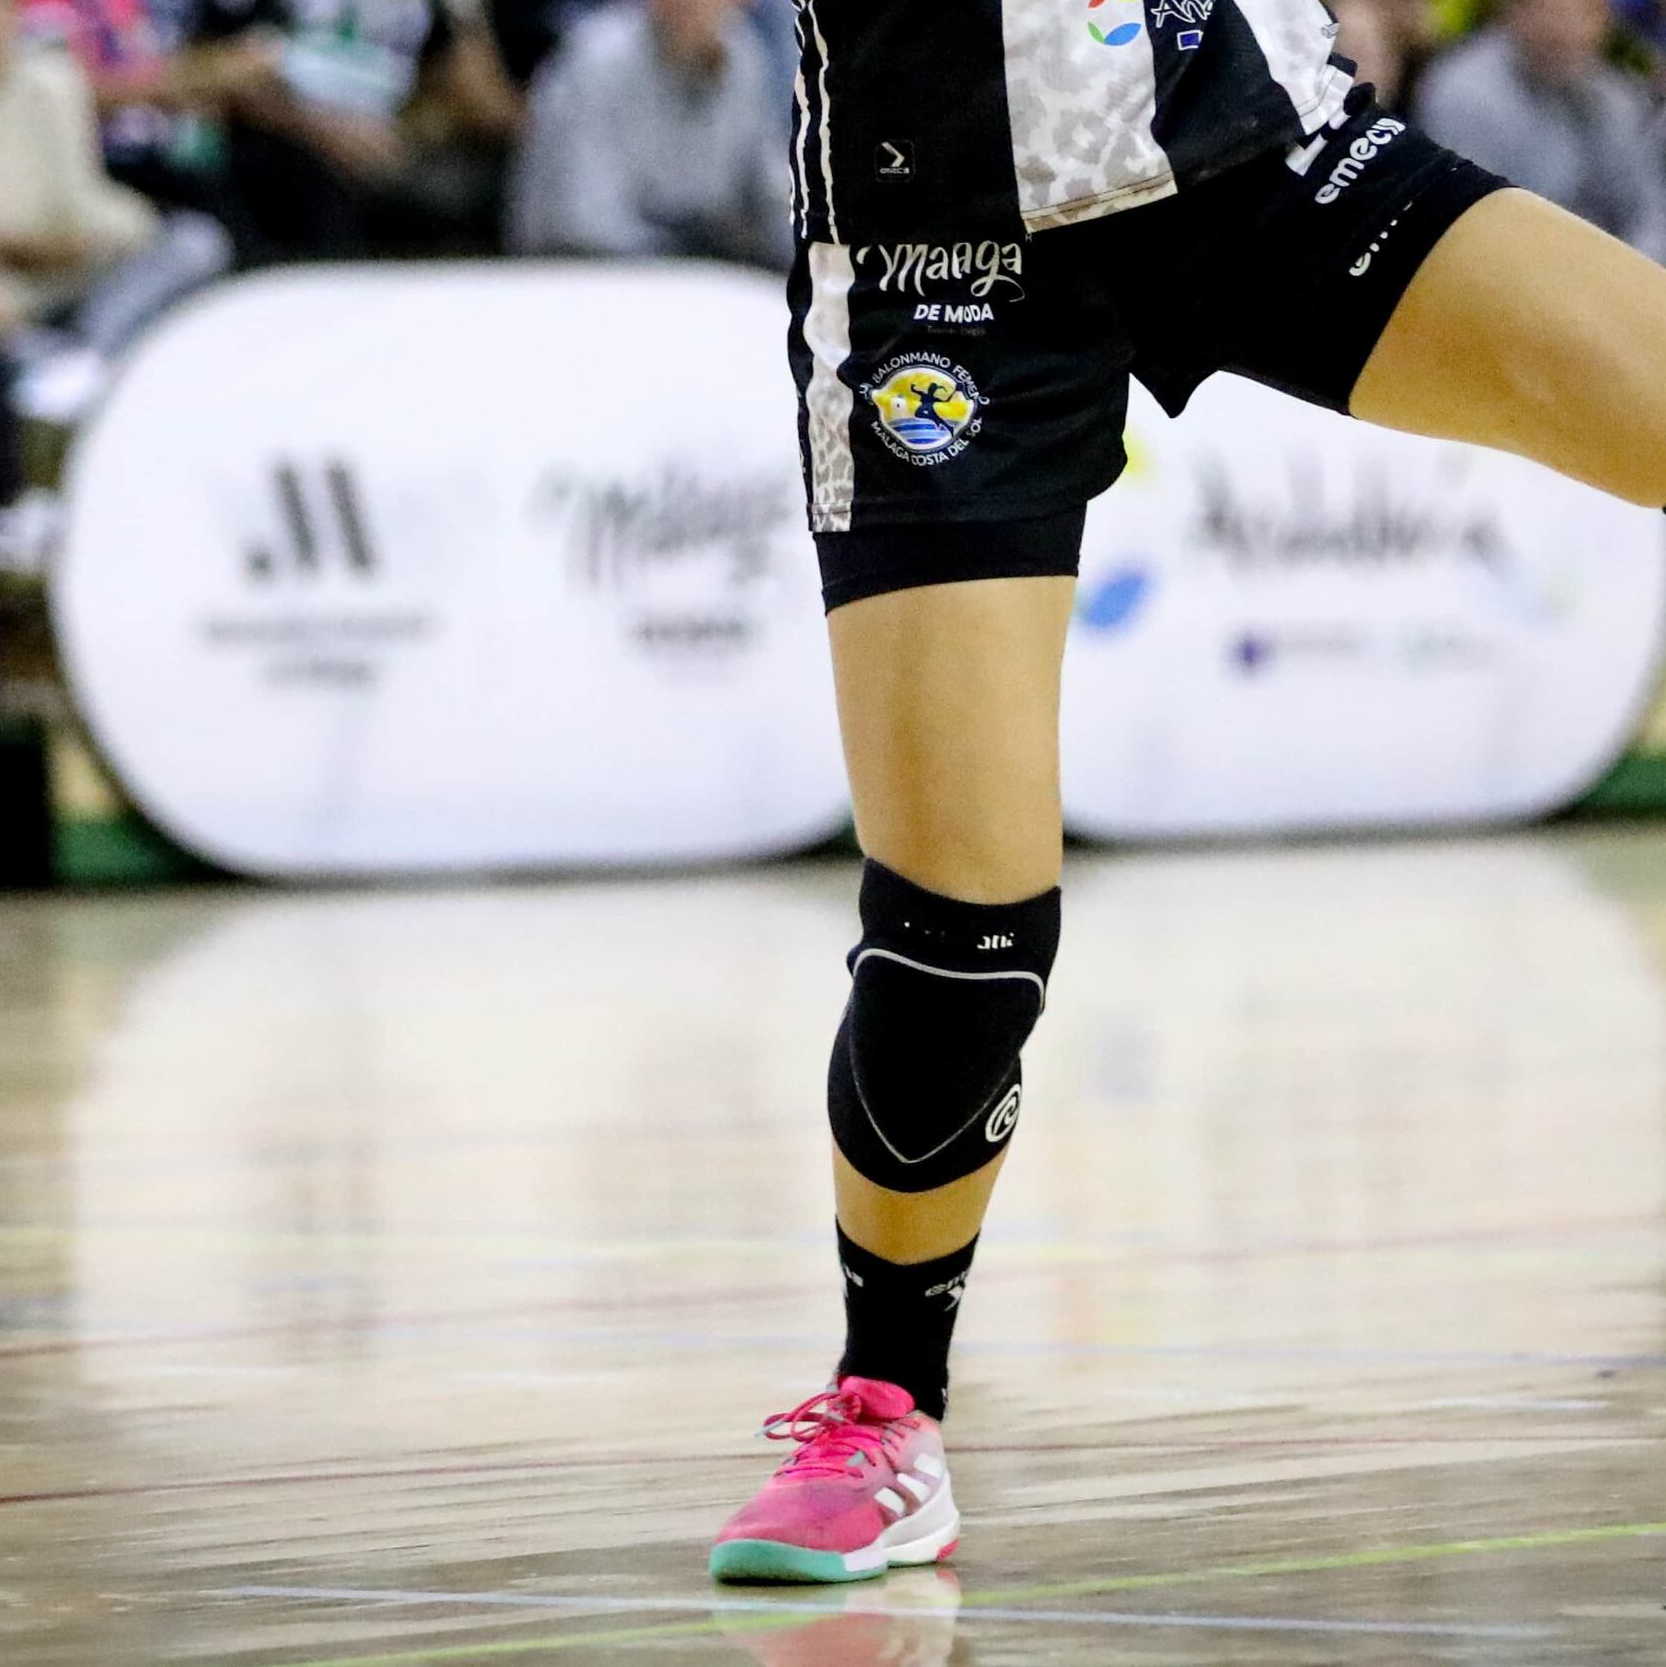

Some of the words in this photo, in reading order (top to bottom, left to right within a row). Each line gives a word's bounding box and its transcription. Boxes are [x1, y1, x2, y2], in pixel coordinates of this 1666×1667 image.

[914, 303, 940, 321] DE
[944, 303, 995, 323] MODA
[947, 438, 970, 457] DEL
